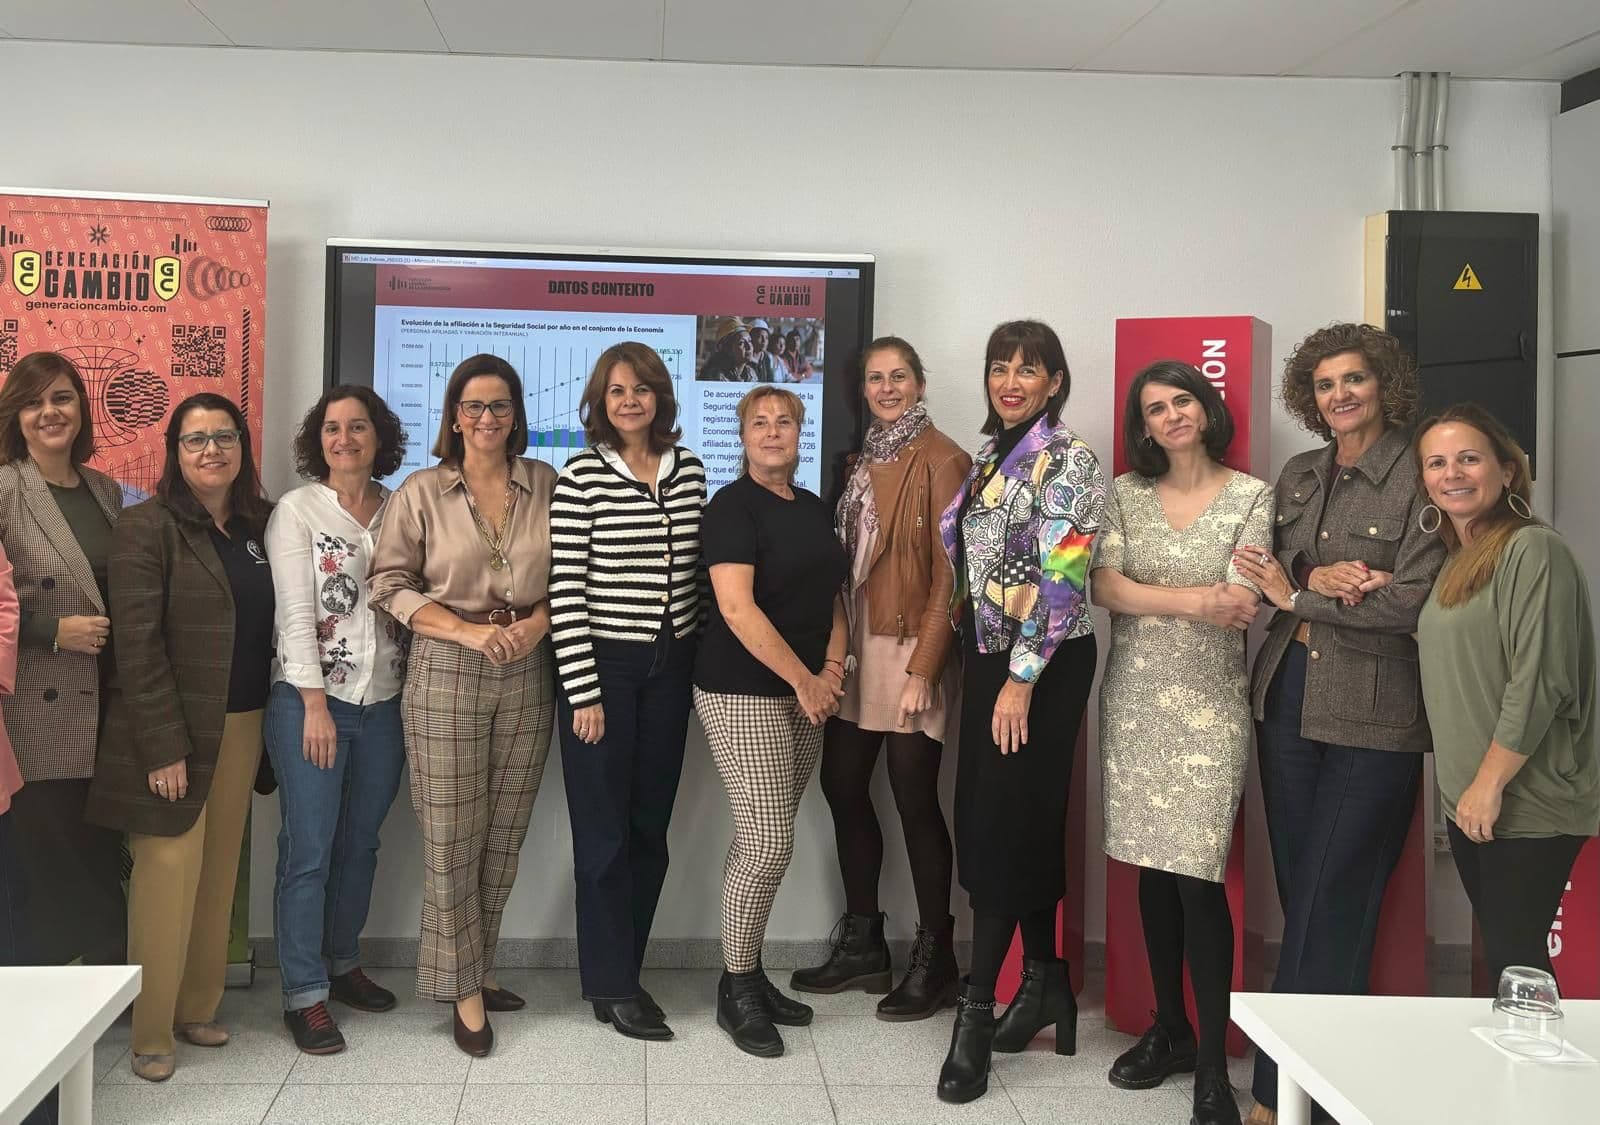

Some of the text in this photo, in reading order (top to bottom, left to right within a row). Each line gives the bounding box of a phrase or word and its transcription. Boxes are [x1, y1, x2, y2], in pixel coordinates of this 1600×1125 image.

[45, 250, 150, 270] GENERACIÓN
[44, 269, 149, 300] CAMBIO
[548, 280, 655, 297] DATOS CONTEXTO
[769, 293, 811, 306] CAMBIO
[26, 300, 167, 313] generacioncambio.com
[450, 320, 479, 328] afiliación
[493, 321, 526, 330] Seguridad
[527, 322, 546, 330] Social
[559, 323, 571, 331] año
[588, 325, 616, 333] conjunto
[617, 325, 625, 333] de
[626, 325, 633, 333] la
[634, 326, 664, 334] Economía
[703, 390, 745, 399] De acuerdo
[807, 392, 814, 400] la
[703, 402, 737, 412] Segurida
[807, 417, 815, 425] la
[702, 440, 733, 448] afiliadas
[712, 466, 727, 474] que
[728, 465, 735, 474] el
